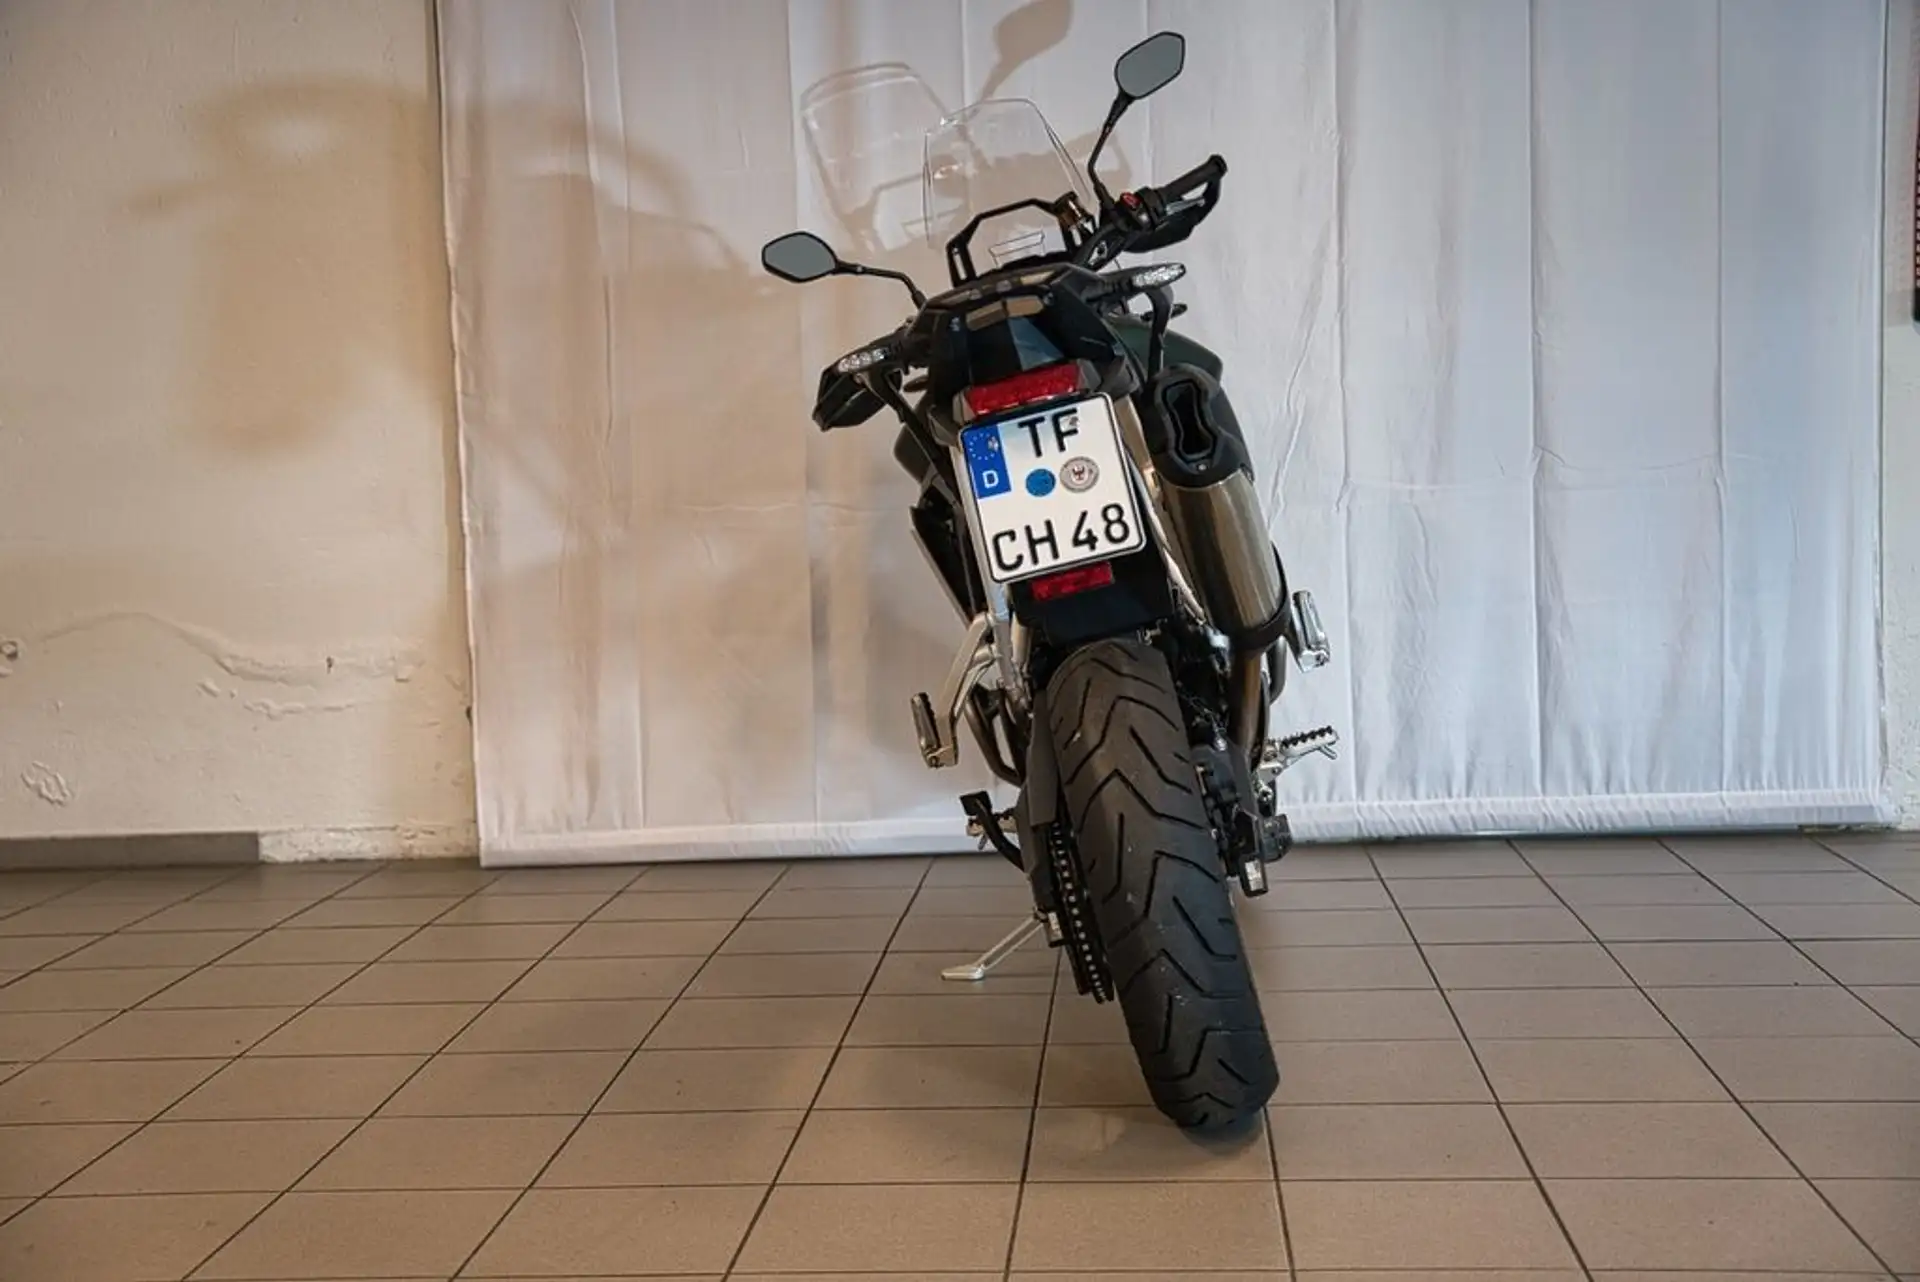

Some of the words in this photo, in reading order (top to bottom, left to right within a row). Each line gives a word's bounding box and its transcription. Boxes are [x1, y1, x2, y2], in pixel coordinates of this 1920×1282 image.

[1017, 408, 1079, 458] TF
[982, 470, 999, 489] D
[992, 519, 1060, 571] CH
[1072, 503, 1130, 551] 48
